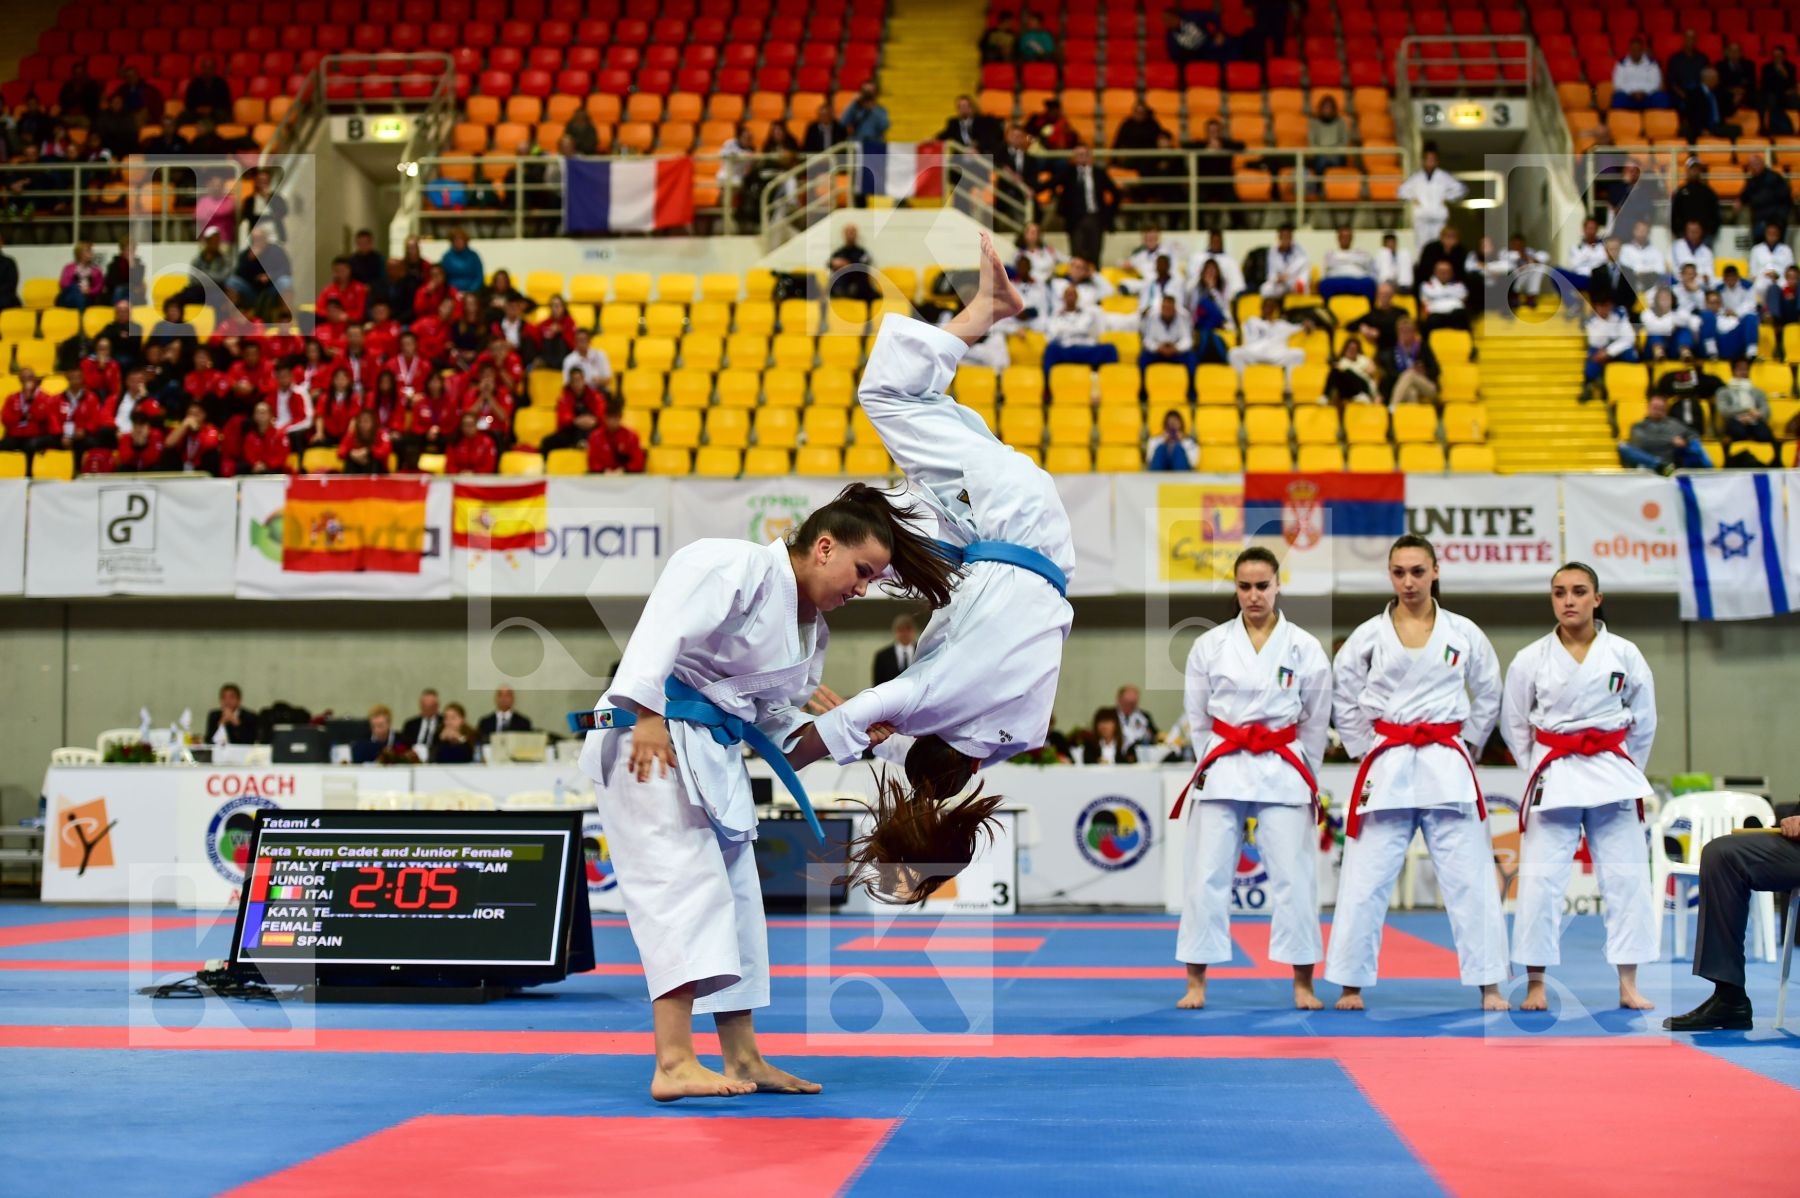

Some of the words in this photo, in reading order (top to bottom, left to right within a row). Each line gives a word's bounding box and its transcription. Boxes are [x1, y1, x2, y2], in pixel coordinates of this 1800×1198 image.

[1493, 102, 1510, 127] 3
[347, 117, 365, 140] B
[1405, 506, 1534, 537] UNITE
[1432, 538, 1552, 563] ECURITÉ
[206, 774, 296, 797] COACH
[262, 817, 309, 829] Tatami
[311, 817, 321, 829] 4
[259, 846, 292, 857] Kata
[296, 846, 334, 857] Team
[337, 846, 379, 858] Cadet
[381, 846, 410, 858] and
[411, 846, 459, 859] Junior
[461, 846, 513, 859] Female
[275, 861, 318, 872] ITALY
[268, 875, 326, 886] JUNIOR
[348, 866, 459, 910] 2:05
[992, 882, 1010, 906] 3
[267, 907, 308, 918] KATA
[260, 921, 323, 932] FEMALE
[296, 936, 343, 947] SPAIN
